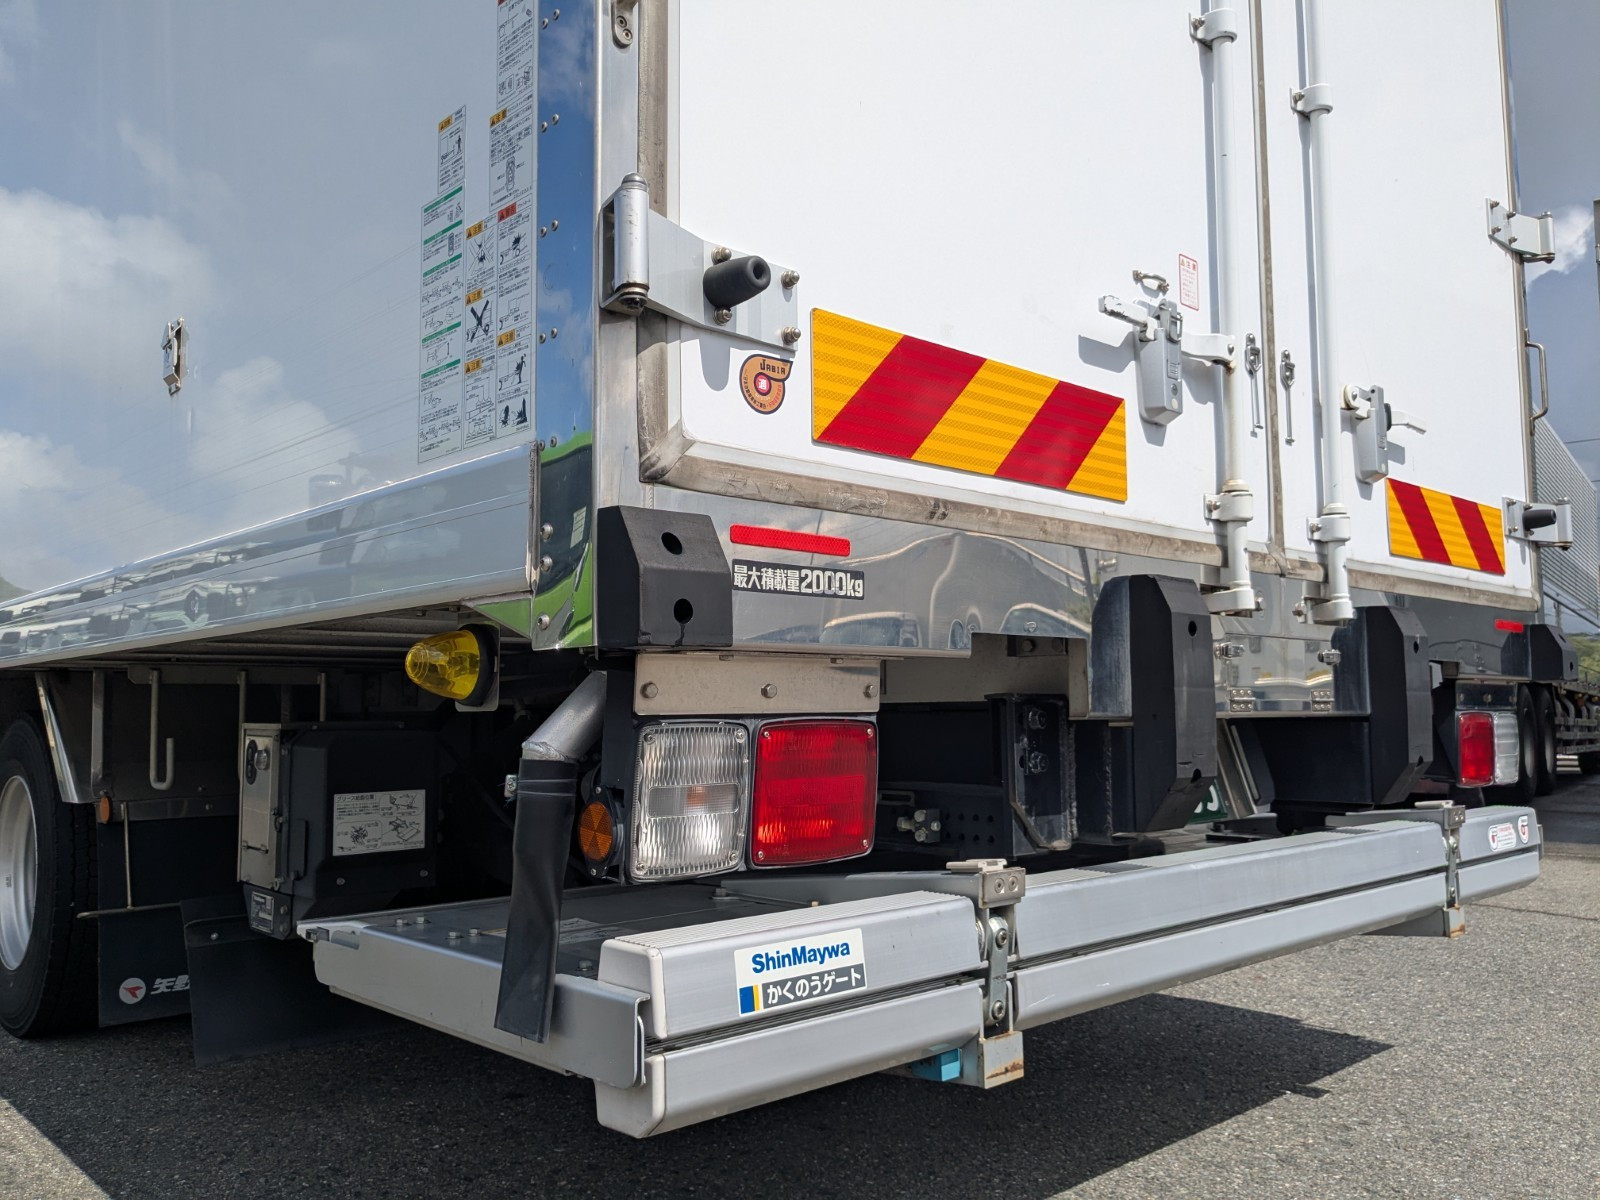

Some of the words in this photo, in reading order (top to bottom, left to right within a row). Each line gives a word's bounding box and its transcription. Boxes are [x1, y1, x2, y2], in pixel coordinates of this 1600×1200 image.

[733, 564, 864, 598] 最大積載量2000kg
[752, 942, 850, 973] ShinMaywa
[767, 968, 861, 1004] かくのうゲート
